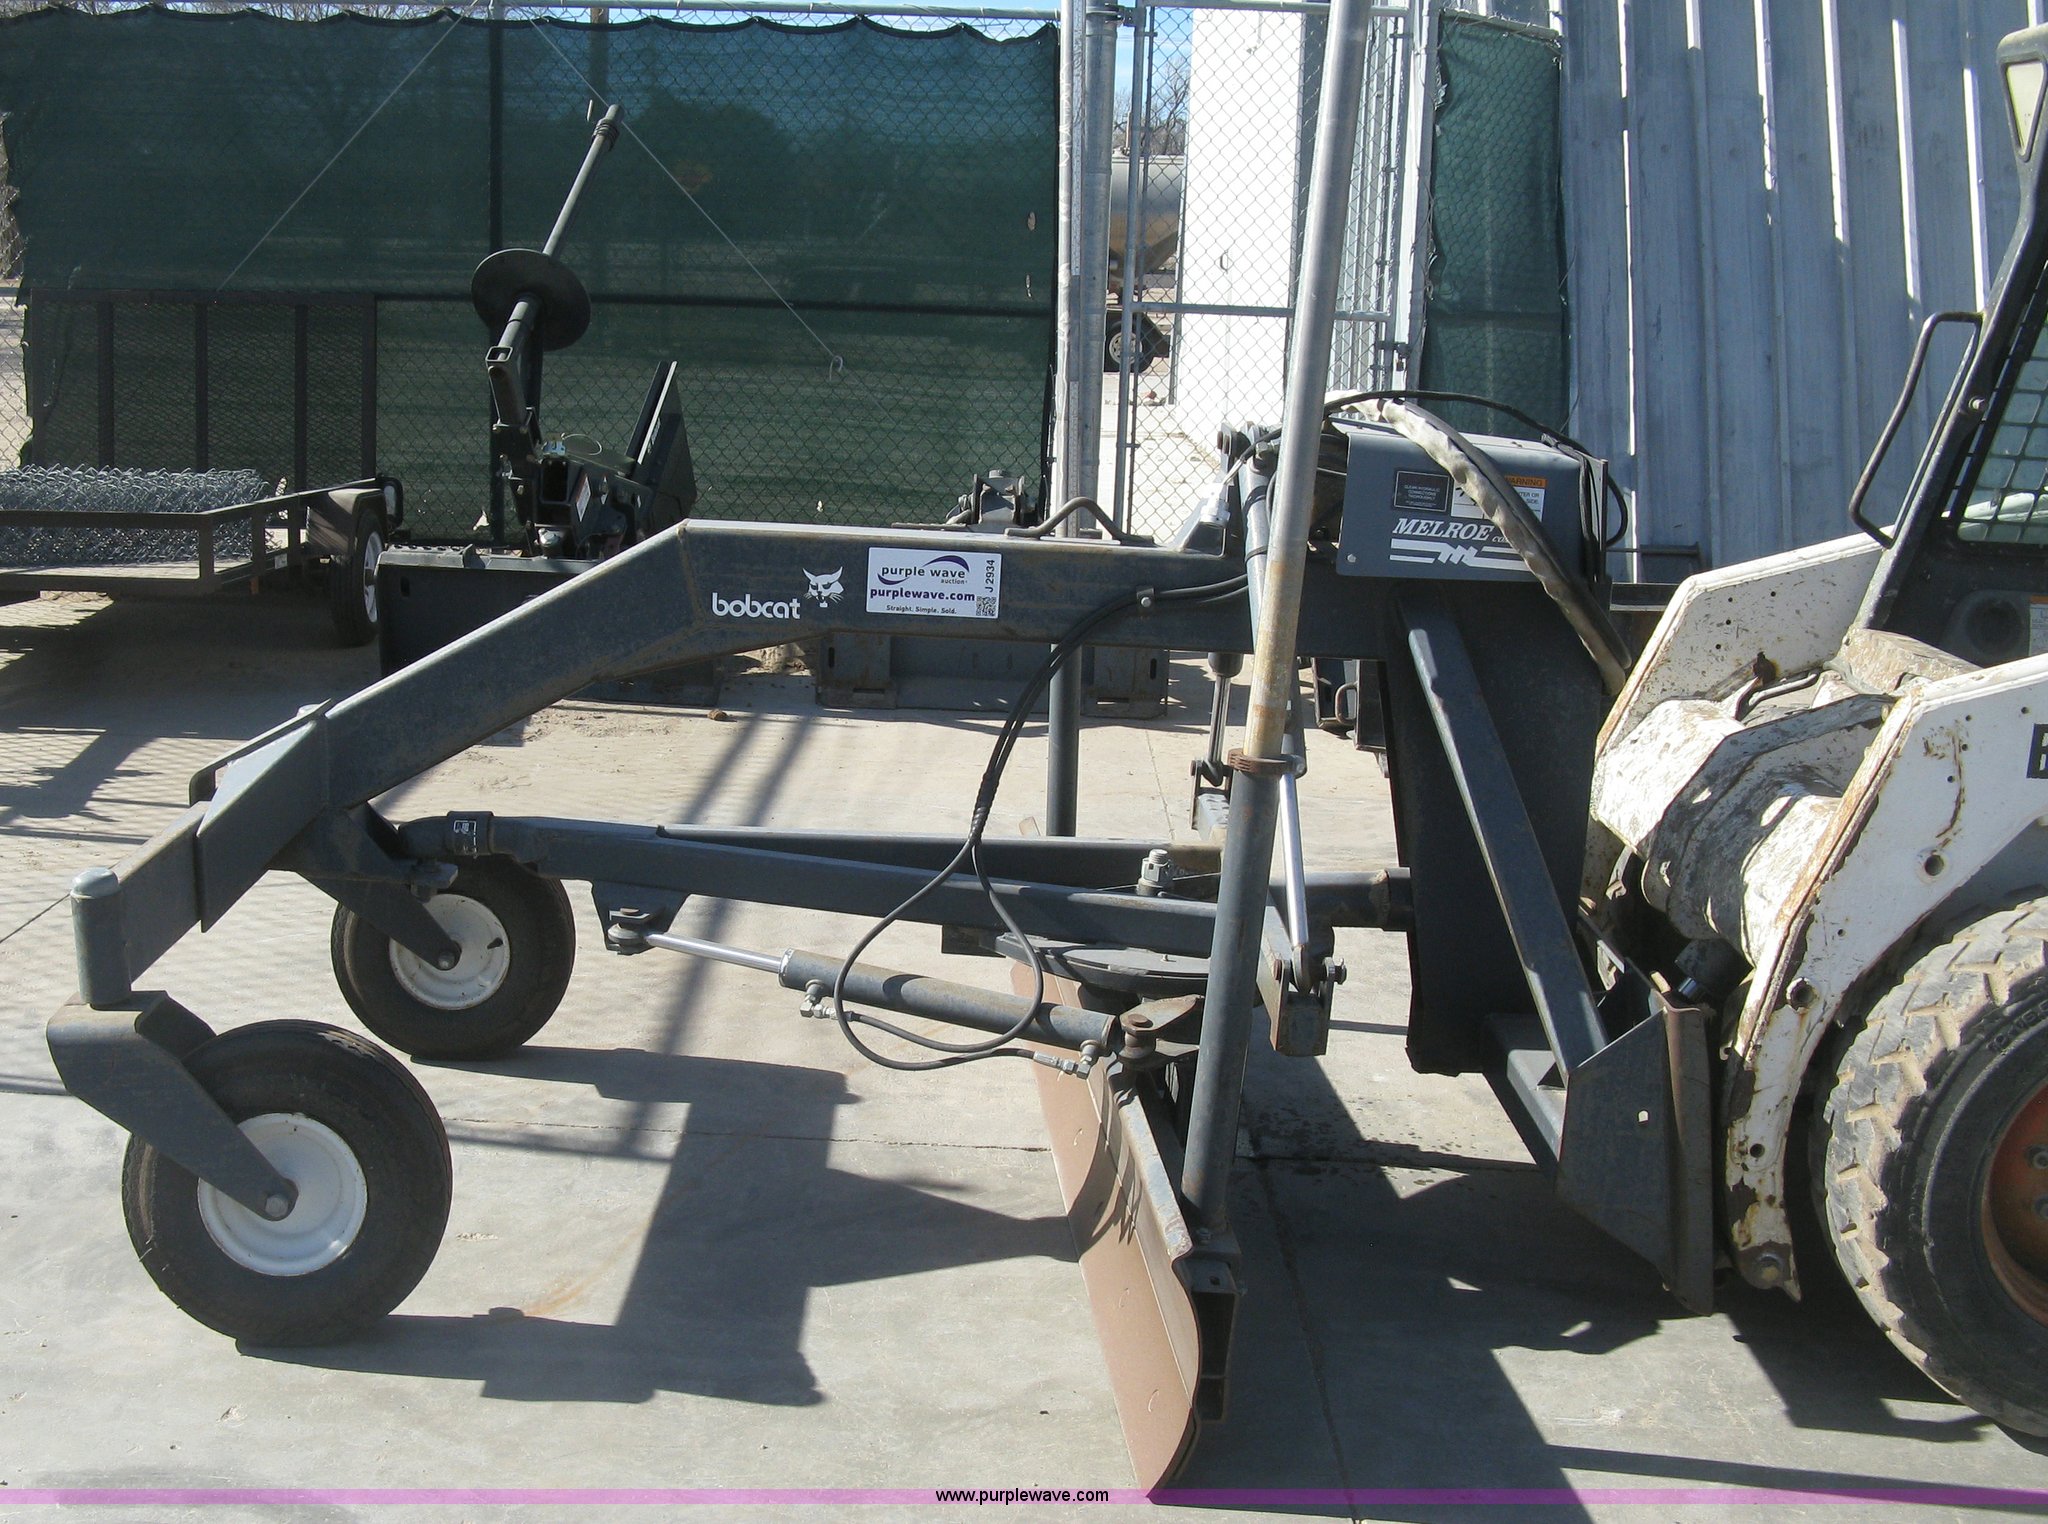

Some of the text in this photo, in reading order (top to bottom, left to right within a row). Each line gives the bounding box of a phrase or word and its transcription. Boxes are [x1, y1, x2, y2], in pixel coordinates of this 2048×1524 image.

[1392, 518, 1496, 541] MELROE
[881, 566, 966, 579] purple wave
[870, 588, 975, 602] purplewave.com
[712, 592, 801, 619] bobcat
[886, 604, 912, 612] Straight.
[915, 606, 940, 614] Simple.
